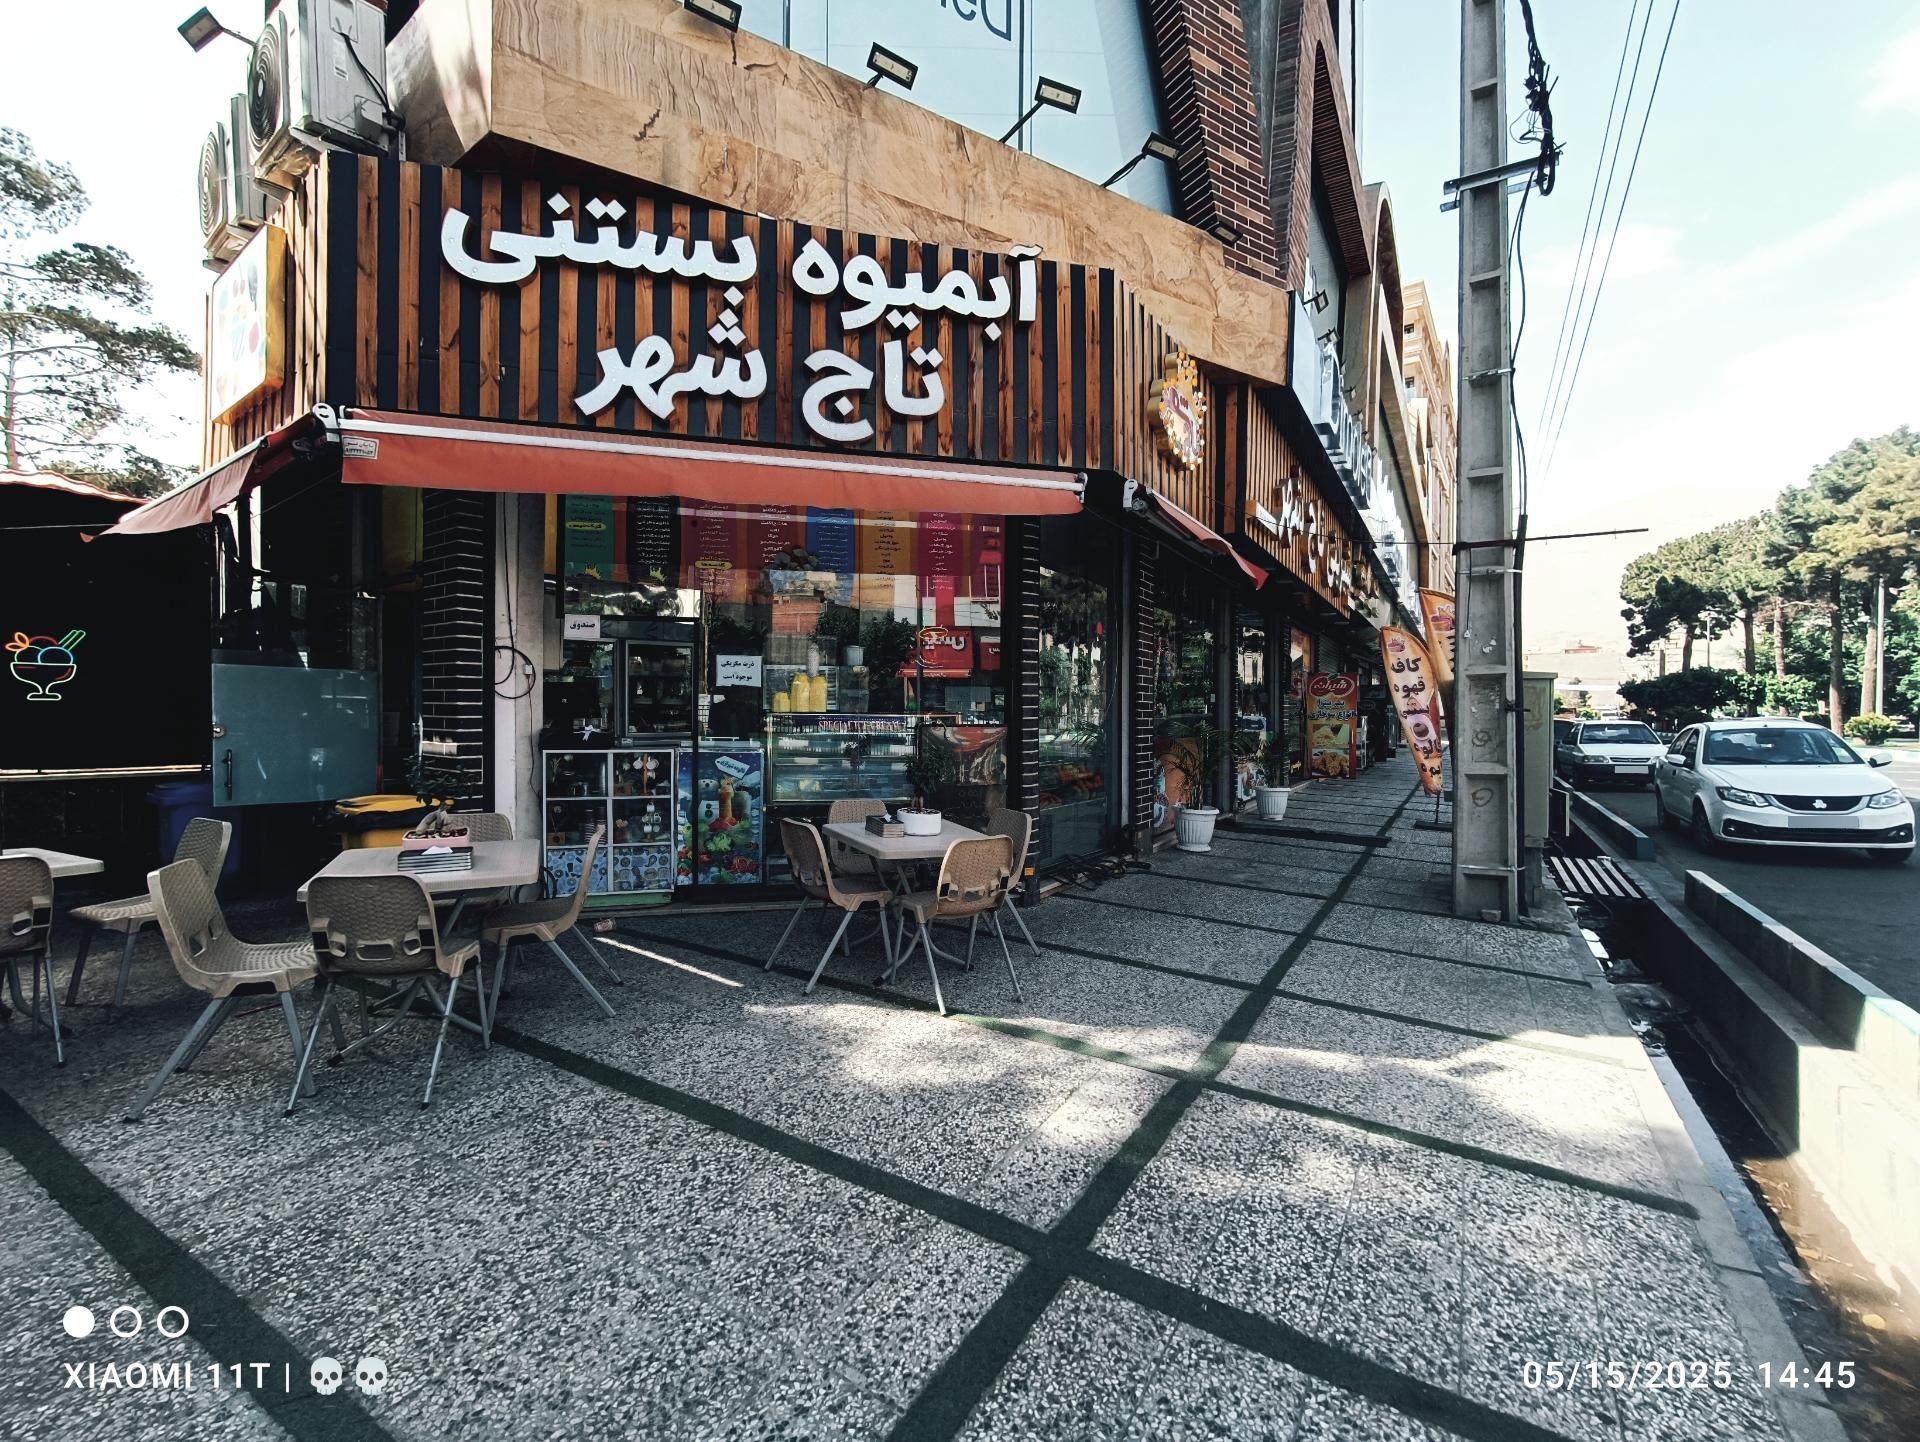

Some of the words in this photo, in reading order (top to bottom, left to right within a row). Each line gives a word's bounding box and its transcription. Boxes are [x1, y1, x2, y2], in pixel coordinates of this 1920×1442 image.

[441, 193, 758, 306] بستنی
[792, 238, 1042, 342] آبمیوه
[574, 308, 767, 419] شهر
[802, 340, 945, 441] تاج
[569, 621, 596, 630] صندوق
[742, 660, 755, 668] ذرت
[1393, 676, 1426, 698] قهوه
